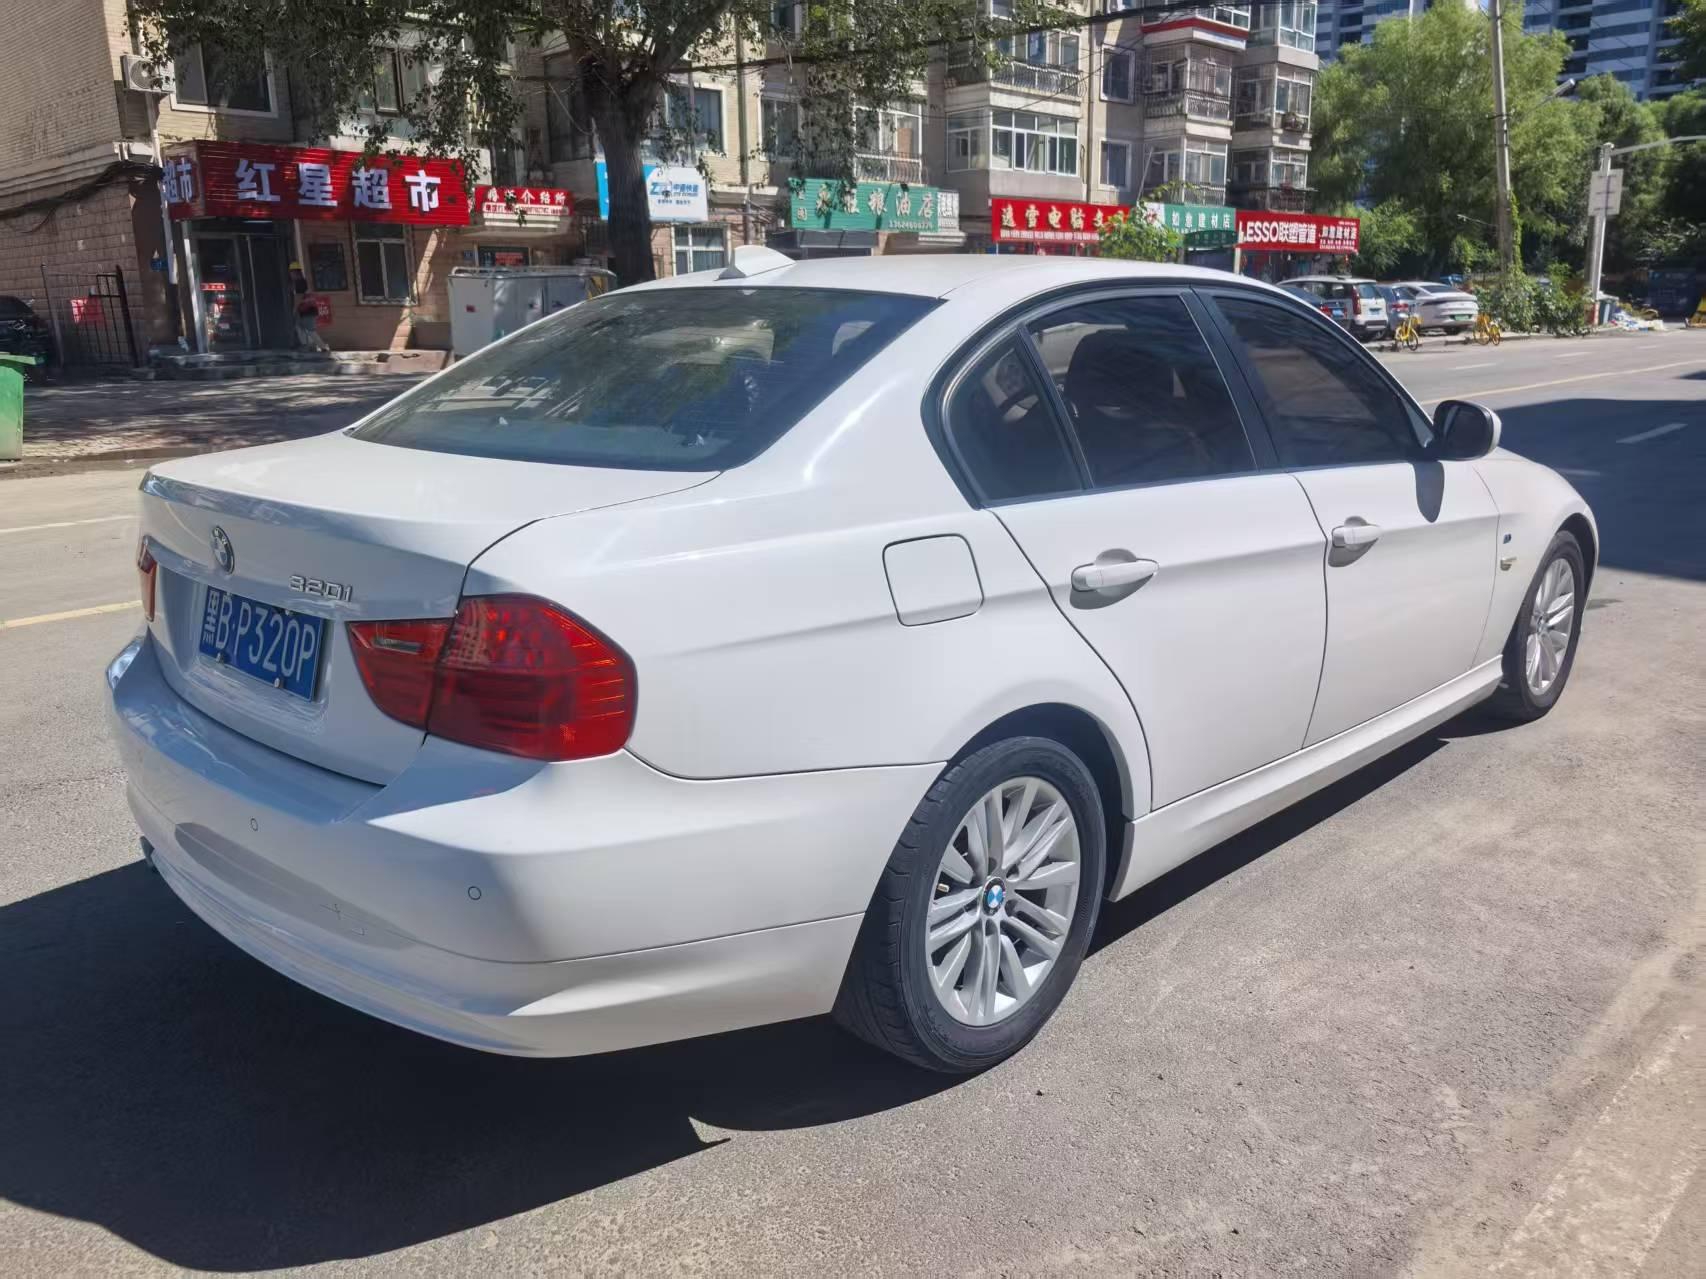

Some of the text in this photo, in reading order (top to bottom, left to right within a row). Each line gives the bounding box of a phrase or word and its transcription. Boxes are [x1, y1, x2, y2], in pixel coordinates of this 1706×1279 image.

[162, 157, 193, 203] 超市
[235, 158, 441, 212] 红星超市
